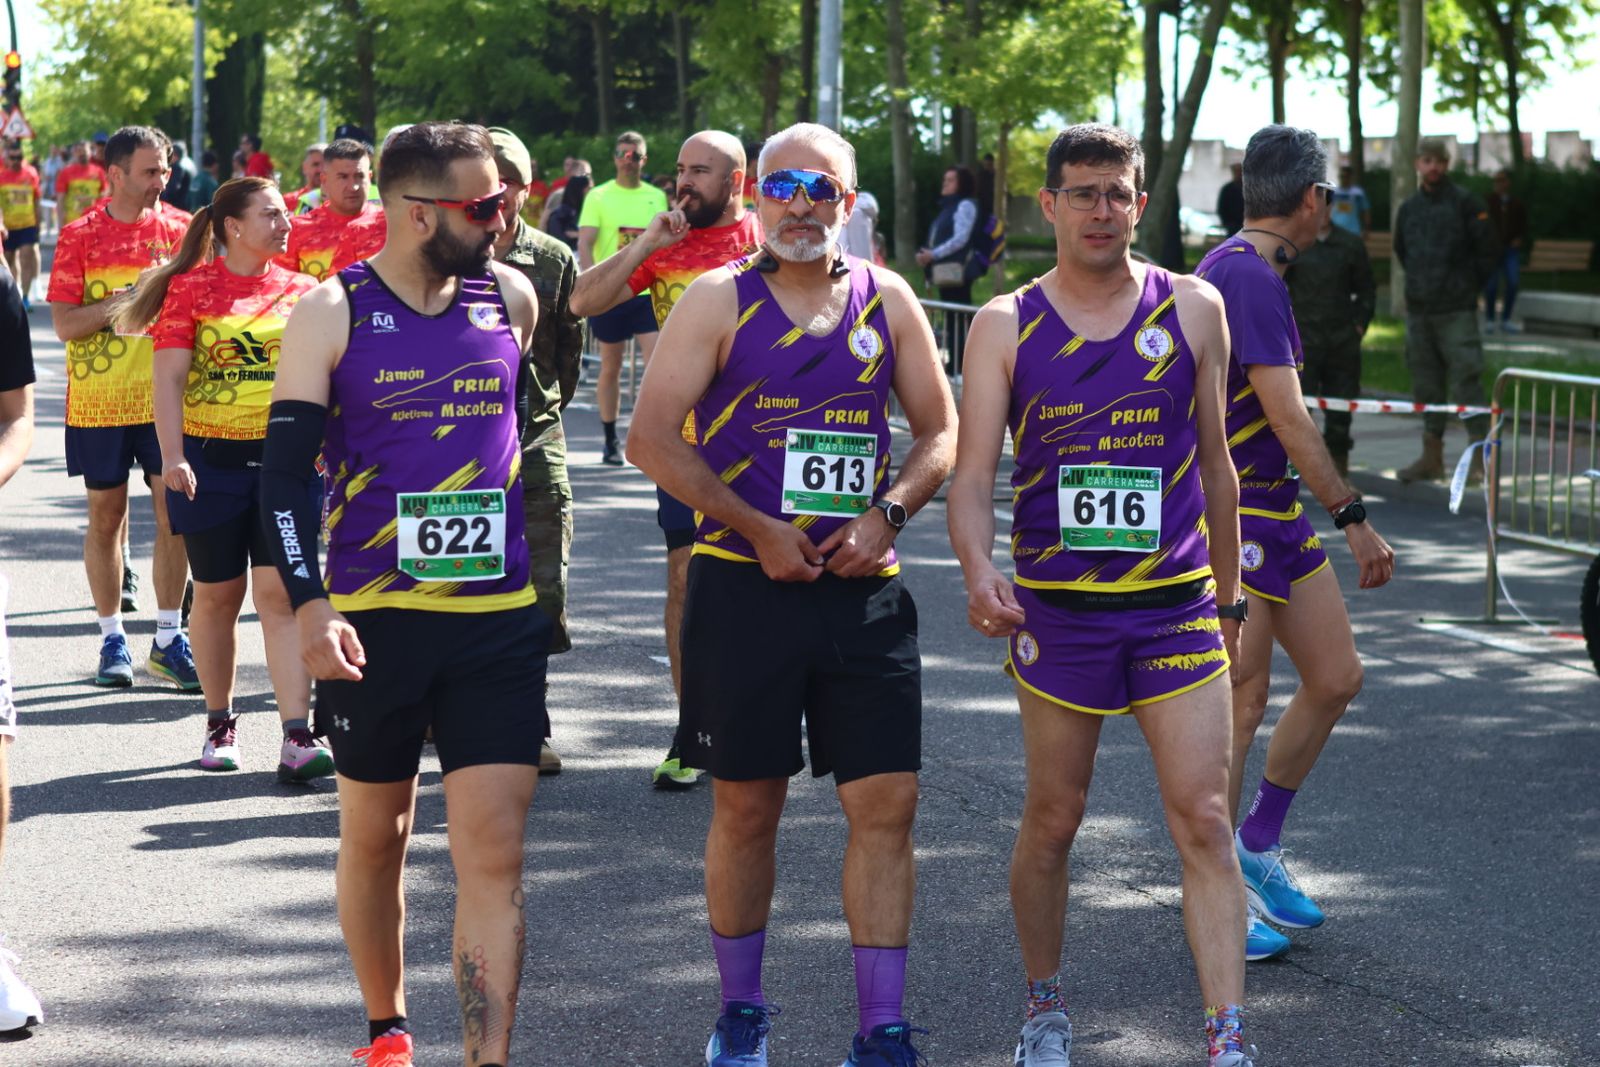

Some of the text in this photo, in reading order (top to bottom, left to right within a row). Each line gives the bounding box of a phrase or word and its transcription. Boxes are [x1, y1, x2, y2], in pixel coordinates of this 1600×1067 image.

[239, 370, 276, 381] FERNAND
[374, 367, 425, 383] Jamón
[453, 377, 501, 393] PRIM
[441, 401, 503, 418] Macotera
[755, 394, 800, 409] Jamón
[824, 409, 869, 425] PRIM
[1039, 401, 1084, 420] Jamón
[1111, 407, 1160, 425] PRIM
[818, 442, 858, 454] CARRERA
[1098, 432, 1165, 451] Macotera
[802, 455, 865, 493] 613
[1087, 477, 1133, 487] CARRERA
[1113, 470, 1152, 480] FERNAND
[432, 502, 479, 513] CARRERA
[1074, 490, 1145, 527] 616
[273, 509, 304, 565] TERREX
[417, 516, 492, 556] 622
